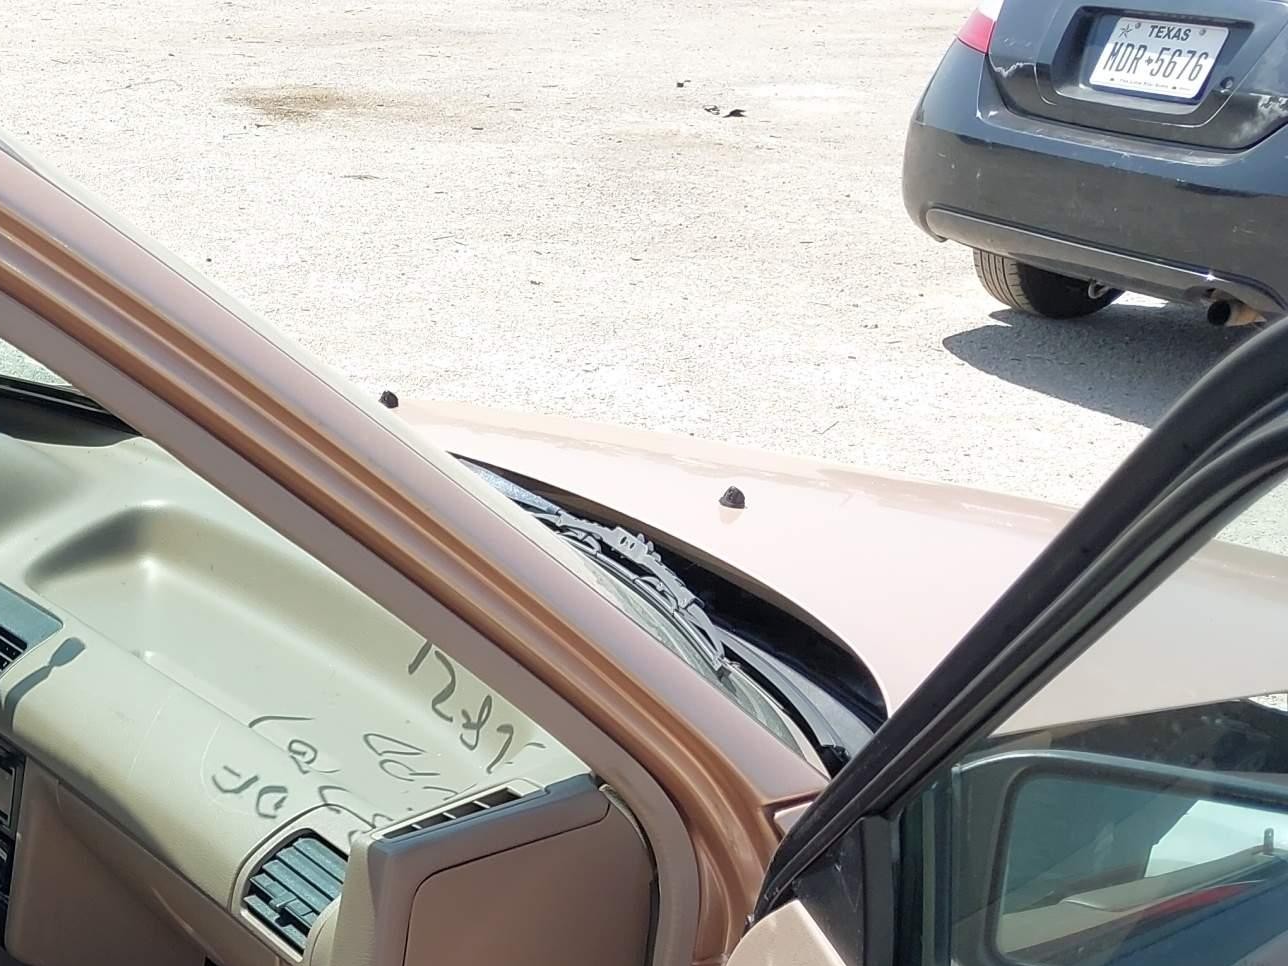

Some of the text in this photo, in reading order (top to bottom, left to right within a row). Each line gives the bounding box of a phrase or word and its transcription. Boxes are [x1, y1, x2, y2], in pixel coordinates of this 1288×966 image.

[1148, 24, 1192, 41] TEXAS
[1103, 41, 1209, 81] MDR 5676
